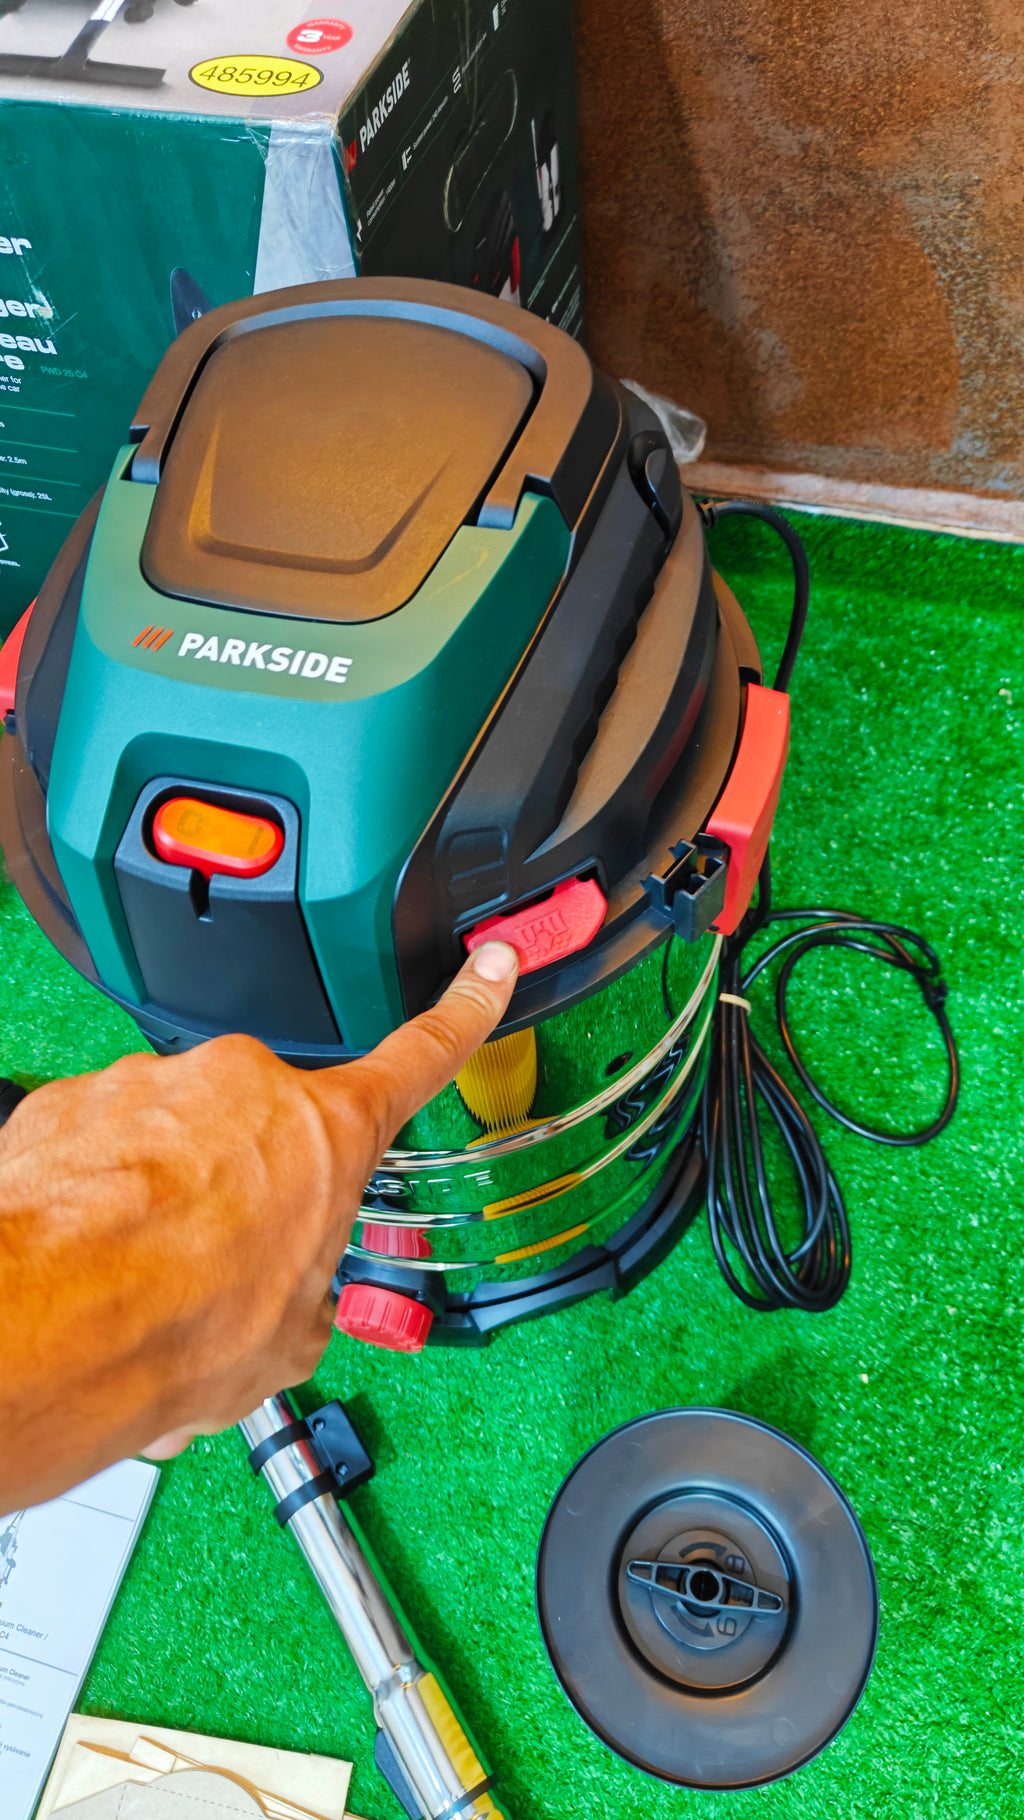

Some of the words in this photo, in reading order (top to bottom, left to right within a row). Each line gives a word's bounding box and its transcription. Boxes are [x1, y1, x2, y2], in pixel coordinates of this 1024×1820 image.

[297, 29, 324, 43] 3
[199, 65, 311, 88] 485994
[359, 60, 411, 153] PARKSIDE
[40, 365, 61, 376] PWD
[62, 369, 74, 378] 25
[177, 632, 353, 684] PARKSIDE
[16, 1623, 43, 1639] Cleaner
